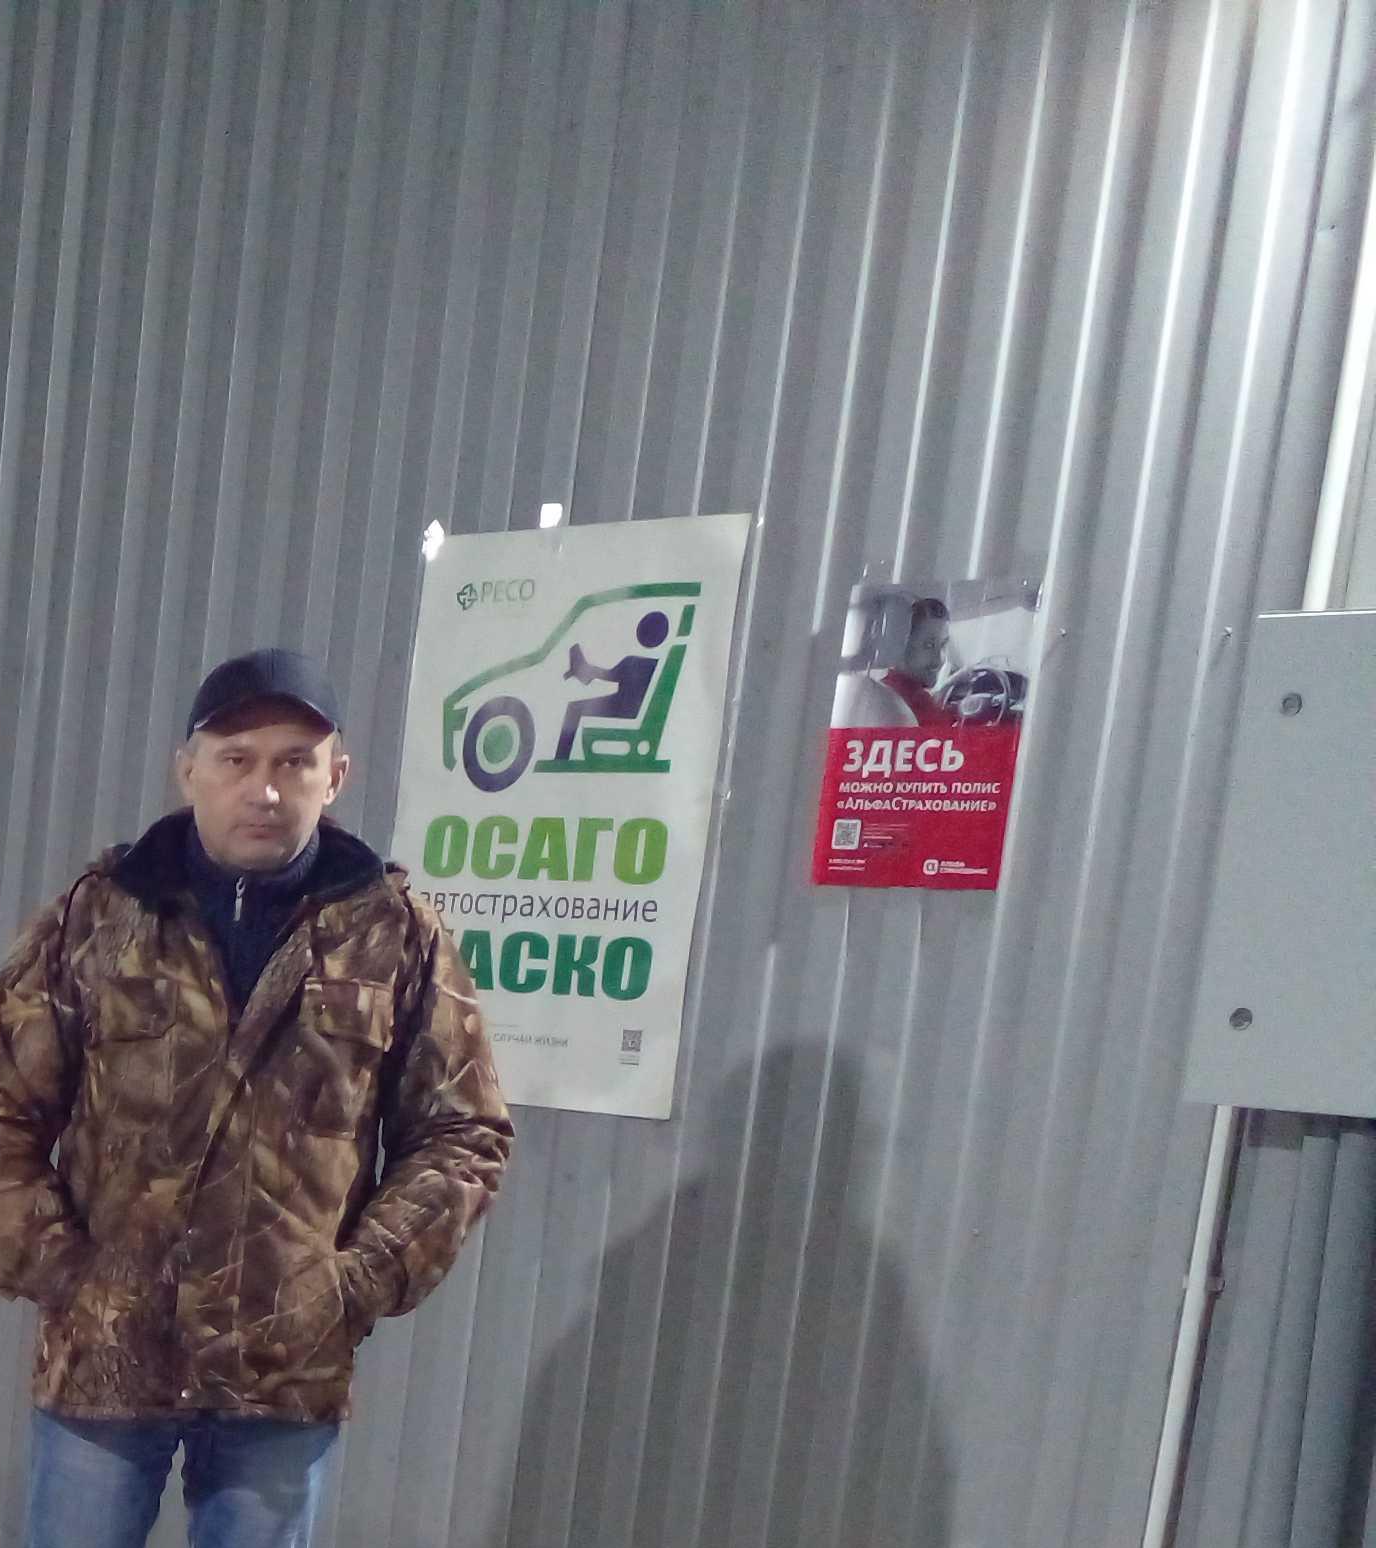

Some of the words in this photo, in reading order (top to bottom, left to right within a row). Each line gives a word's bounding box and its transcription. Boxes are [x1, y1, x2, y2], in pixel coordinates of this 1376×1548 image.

[842, 739, 965, 778] ЗДЕСЬ
[839, 782, 893, 794] МОЖНО
[896, 782, 948, 794] КУПИТЬ
[951, 783, 1001, 794] ПОЛИС
[423, 815, 669, 885] ОСАГО
[446, 929, 654, 1001] АСКО
